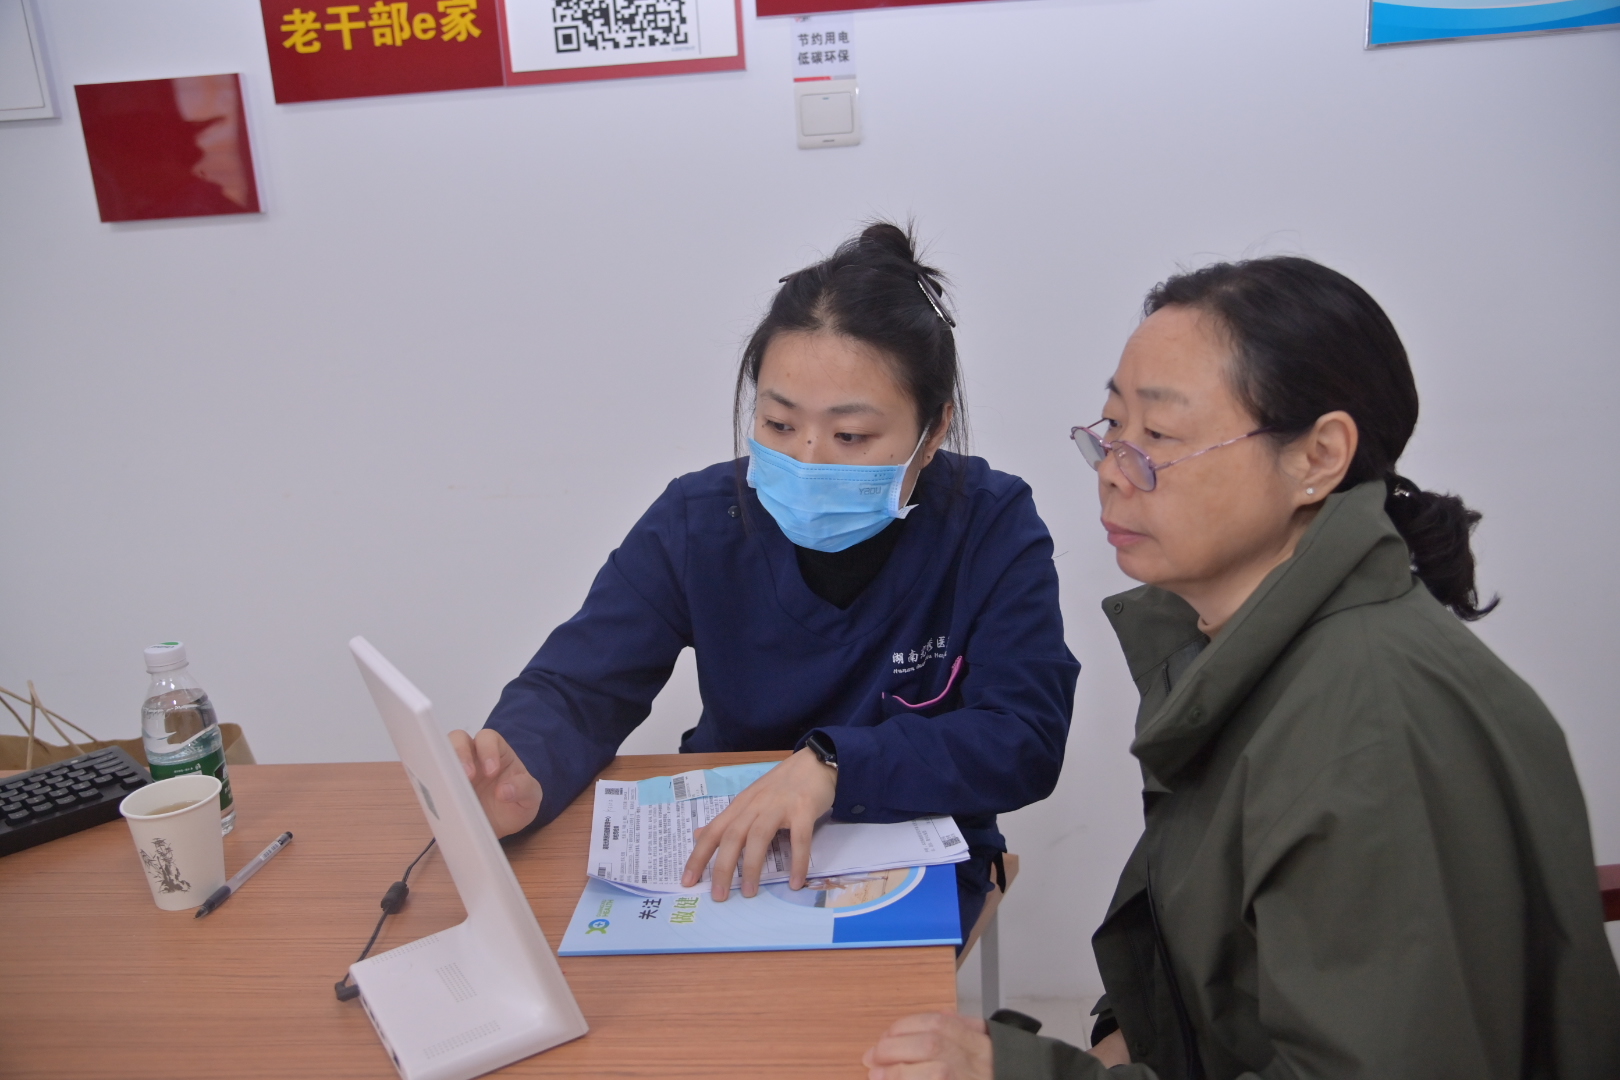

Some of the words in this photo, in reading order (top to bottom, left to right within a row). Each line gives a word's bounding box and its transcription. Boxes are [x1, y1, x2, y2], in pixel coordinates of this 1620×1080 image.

[280, 0, 482, 54] 老干部e家
[797, 31, 850, 47] 节约用电
[797, 49, 850, 65] 低碳环保
[638, 897, 662, 920] 关注
